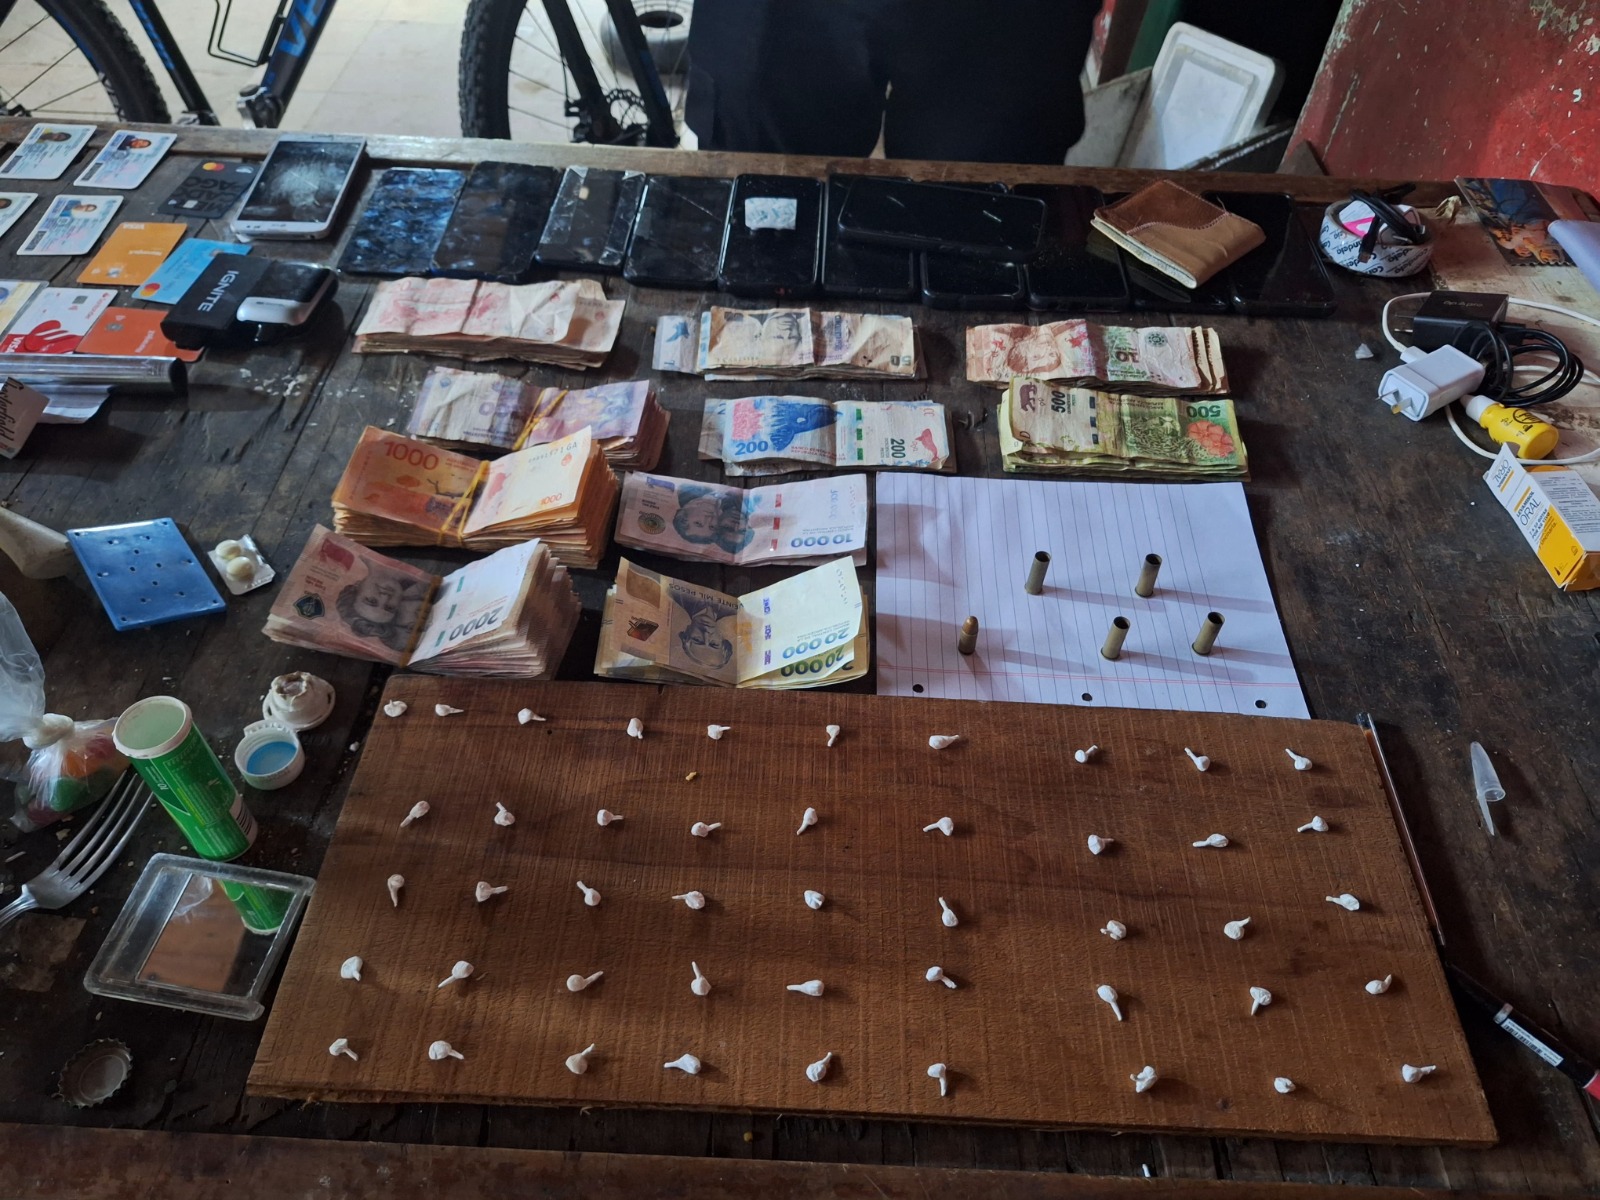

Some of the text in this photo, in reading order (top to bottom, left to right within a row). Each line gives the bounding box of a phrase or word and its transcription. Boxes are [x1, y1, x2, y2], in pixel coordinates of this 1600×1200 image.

[197, 270, 239, 312] IGNITE
[1116, 351, 1139, 363] 10
[1051, 390, 1066, 413] 500
[1186, 405, 1221, 419] 500
[383, 441, 440, 471] 1000
[734, 440, 769, 456] 200
[891, 438, 905, 459] 200
[1493, 459, 1509, 483] ORAL
[1520, 498, 1541, 526] ORAL
[791, 533, 853, 548] 10 000
[669, 583, 744, 610] VEINTE MIL PESOS
[449, 605, 505, 642] 2000
[782, 627, 850, 659] 20 000
[157, 783, 169, 791] 10
